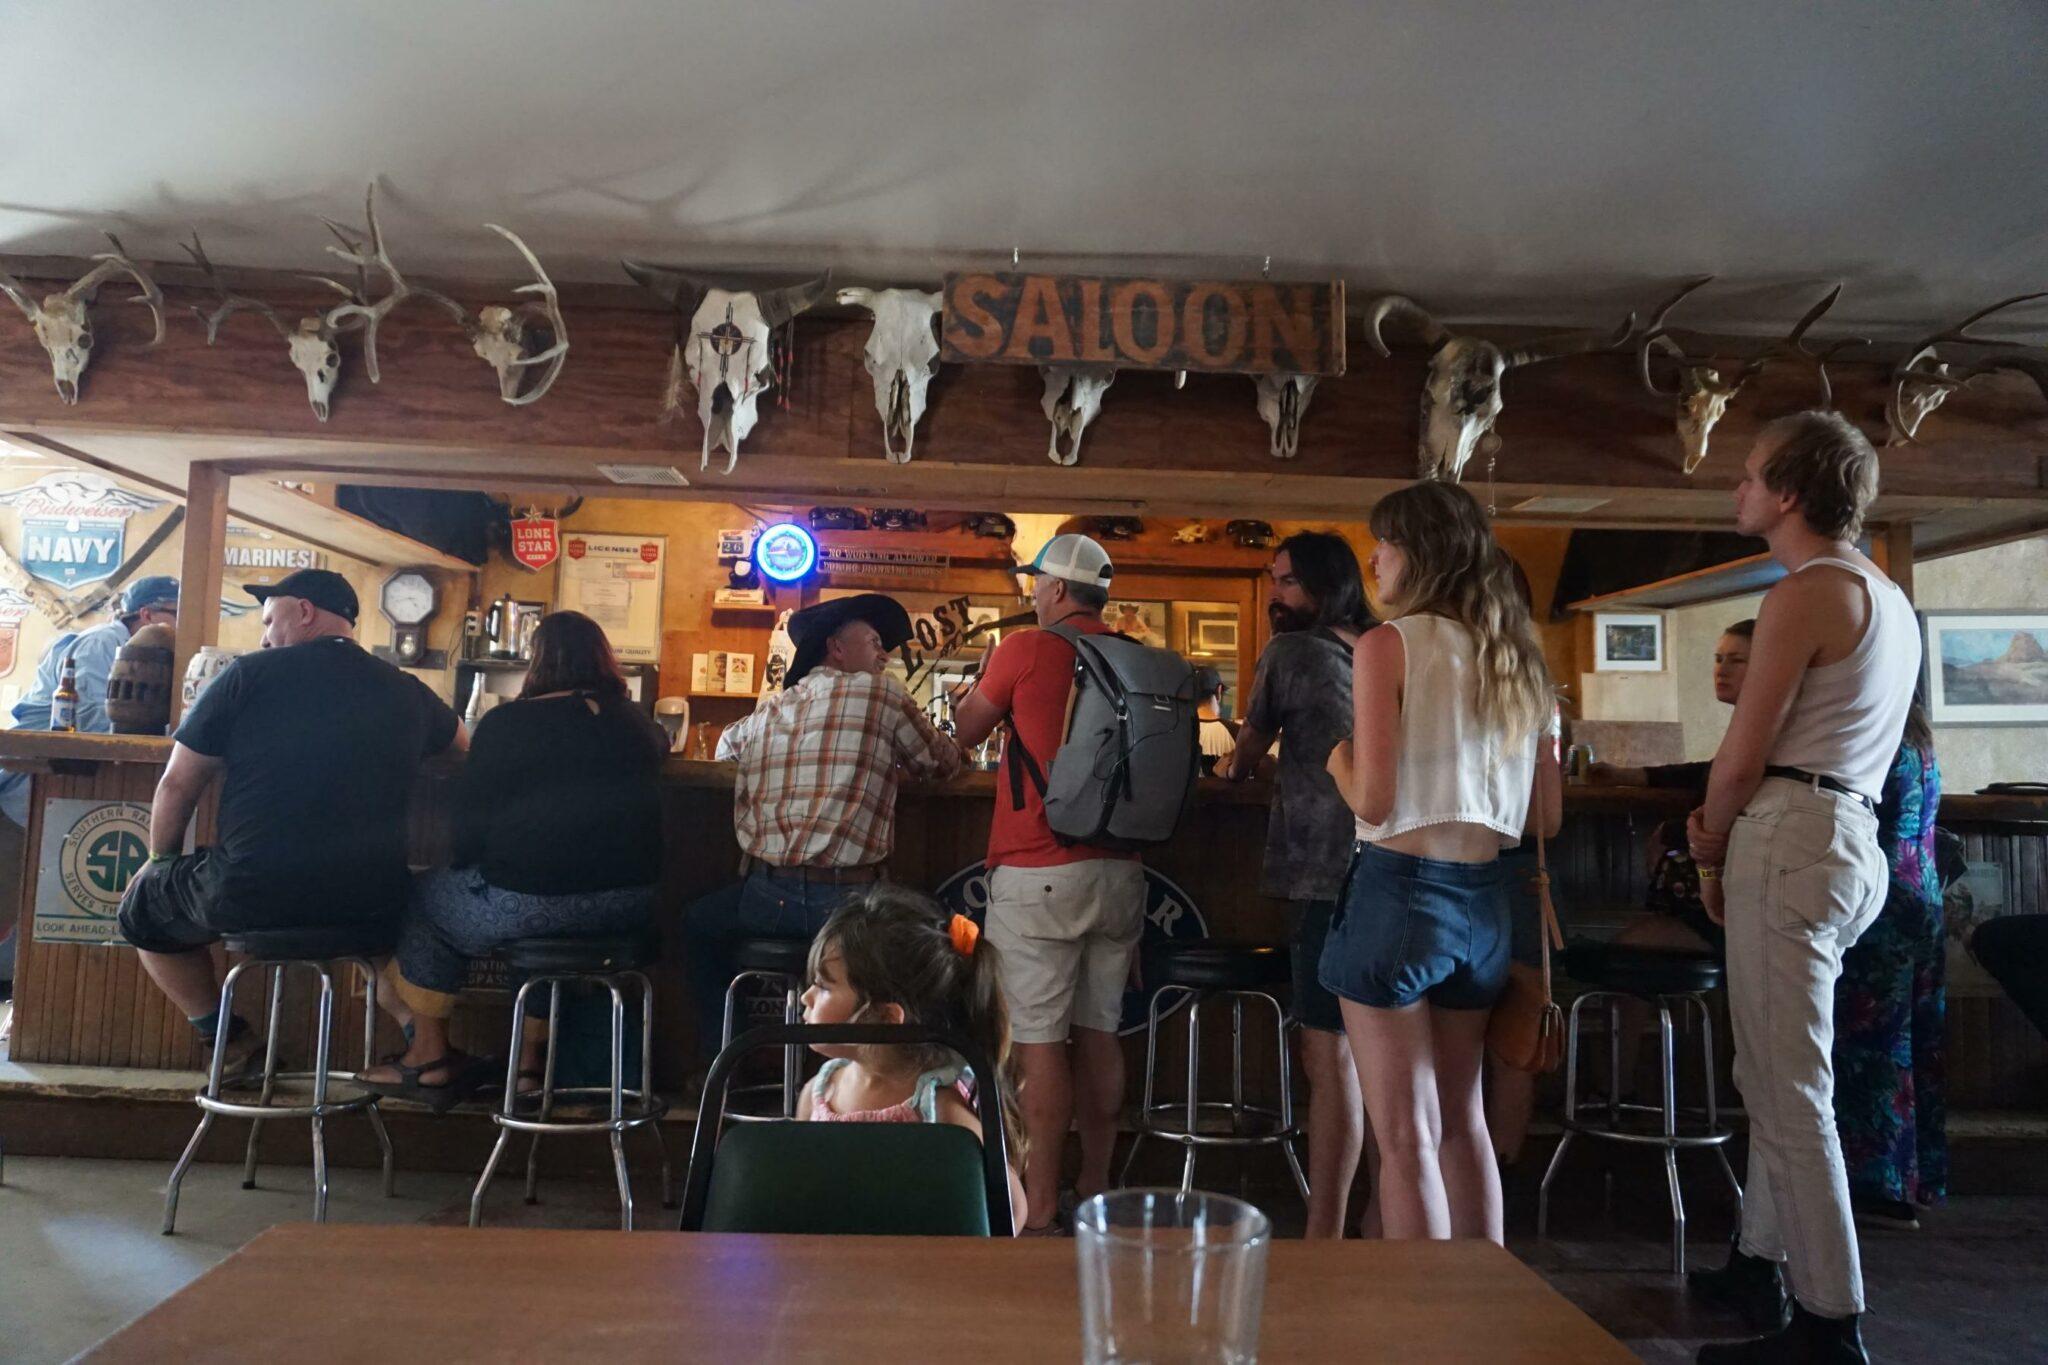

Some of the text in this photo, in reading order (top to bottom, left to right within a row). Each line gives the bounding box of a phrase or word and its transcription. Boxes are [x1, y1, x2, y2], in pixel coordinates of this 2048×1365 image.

[944, 274, 1322, 370] SALOON
[517, 528, 551, 539] LONE
[518, 541, 552, 552] STAR
[27, 535, 116, 564] NAVY
[224, 547, 309, 570] MARINES
[829, 548, 841, 558] NO
[901, 595, 973, 682] LOST
[69, 807, 124, 848] SOUTHERN
[65, 872, 96, 909] SERVES
[36, 921, 65, 933] LOOK
